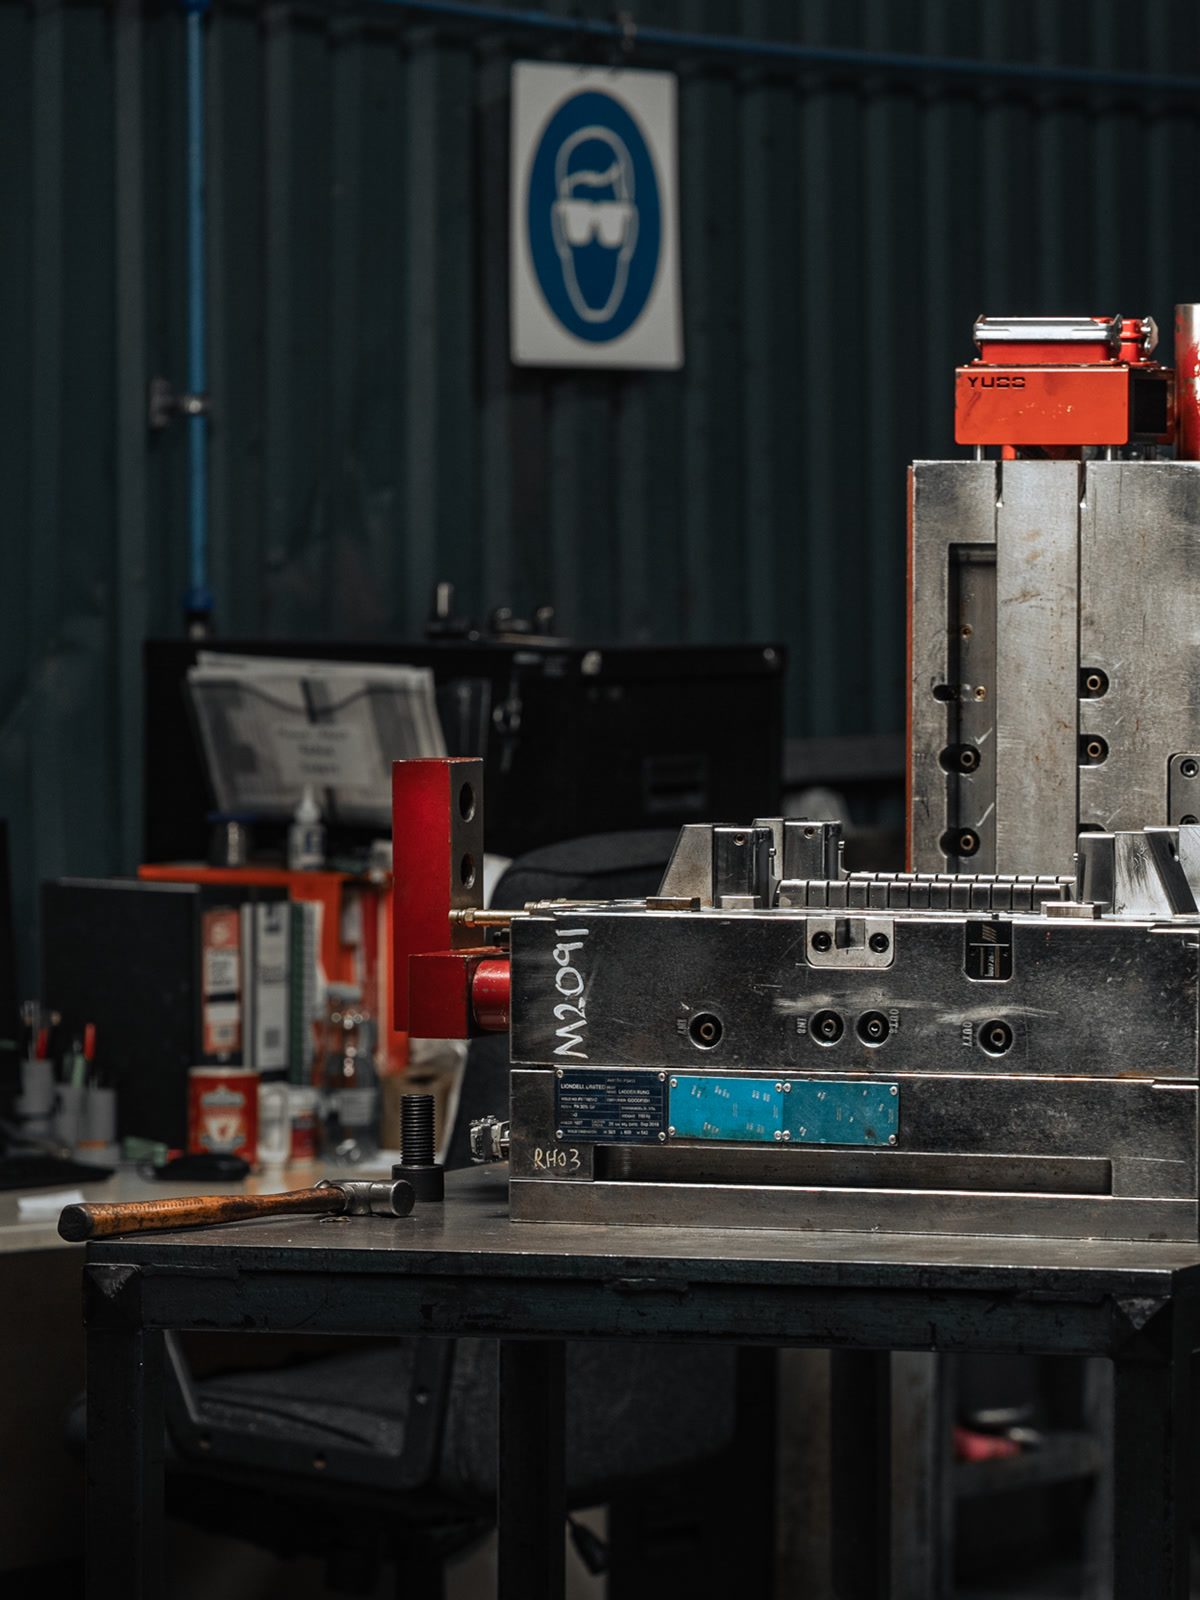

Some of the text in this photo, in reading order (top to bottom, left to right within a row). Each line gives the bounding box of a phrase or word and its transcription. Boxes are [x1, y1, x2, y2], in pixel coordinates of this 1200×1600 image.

[967, 376, 1026, 388] YUDO
[552, 928, 590, 1060] M2091
[534, 1147, 581, 1172] RH03
